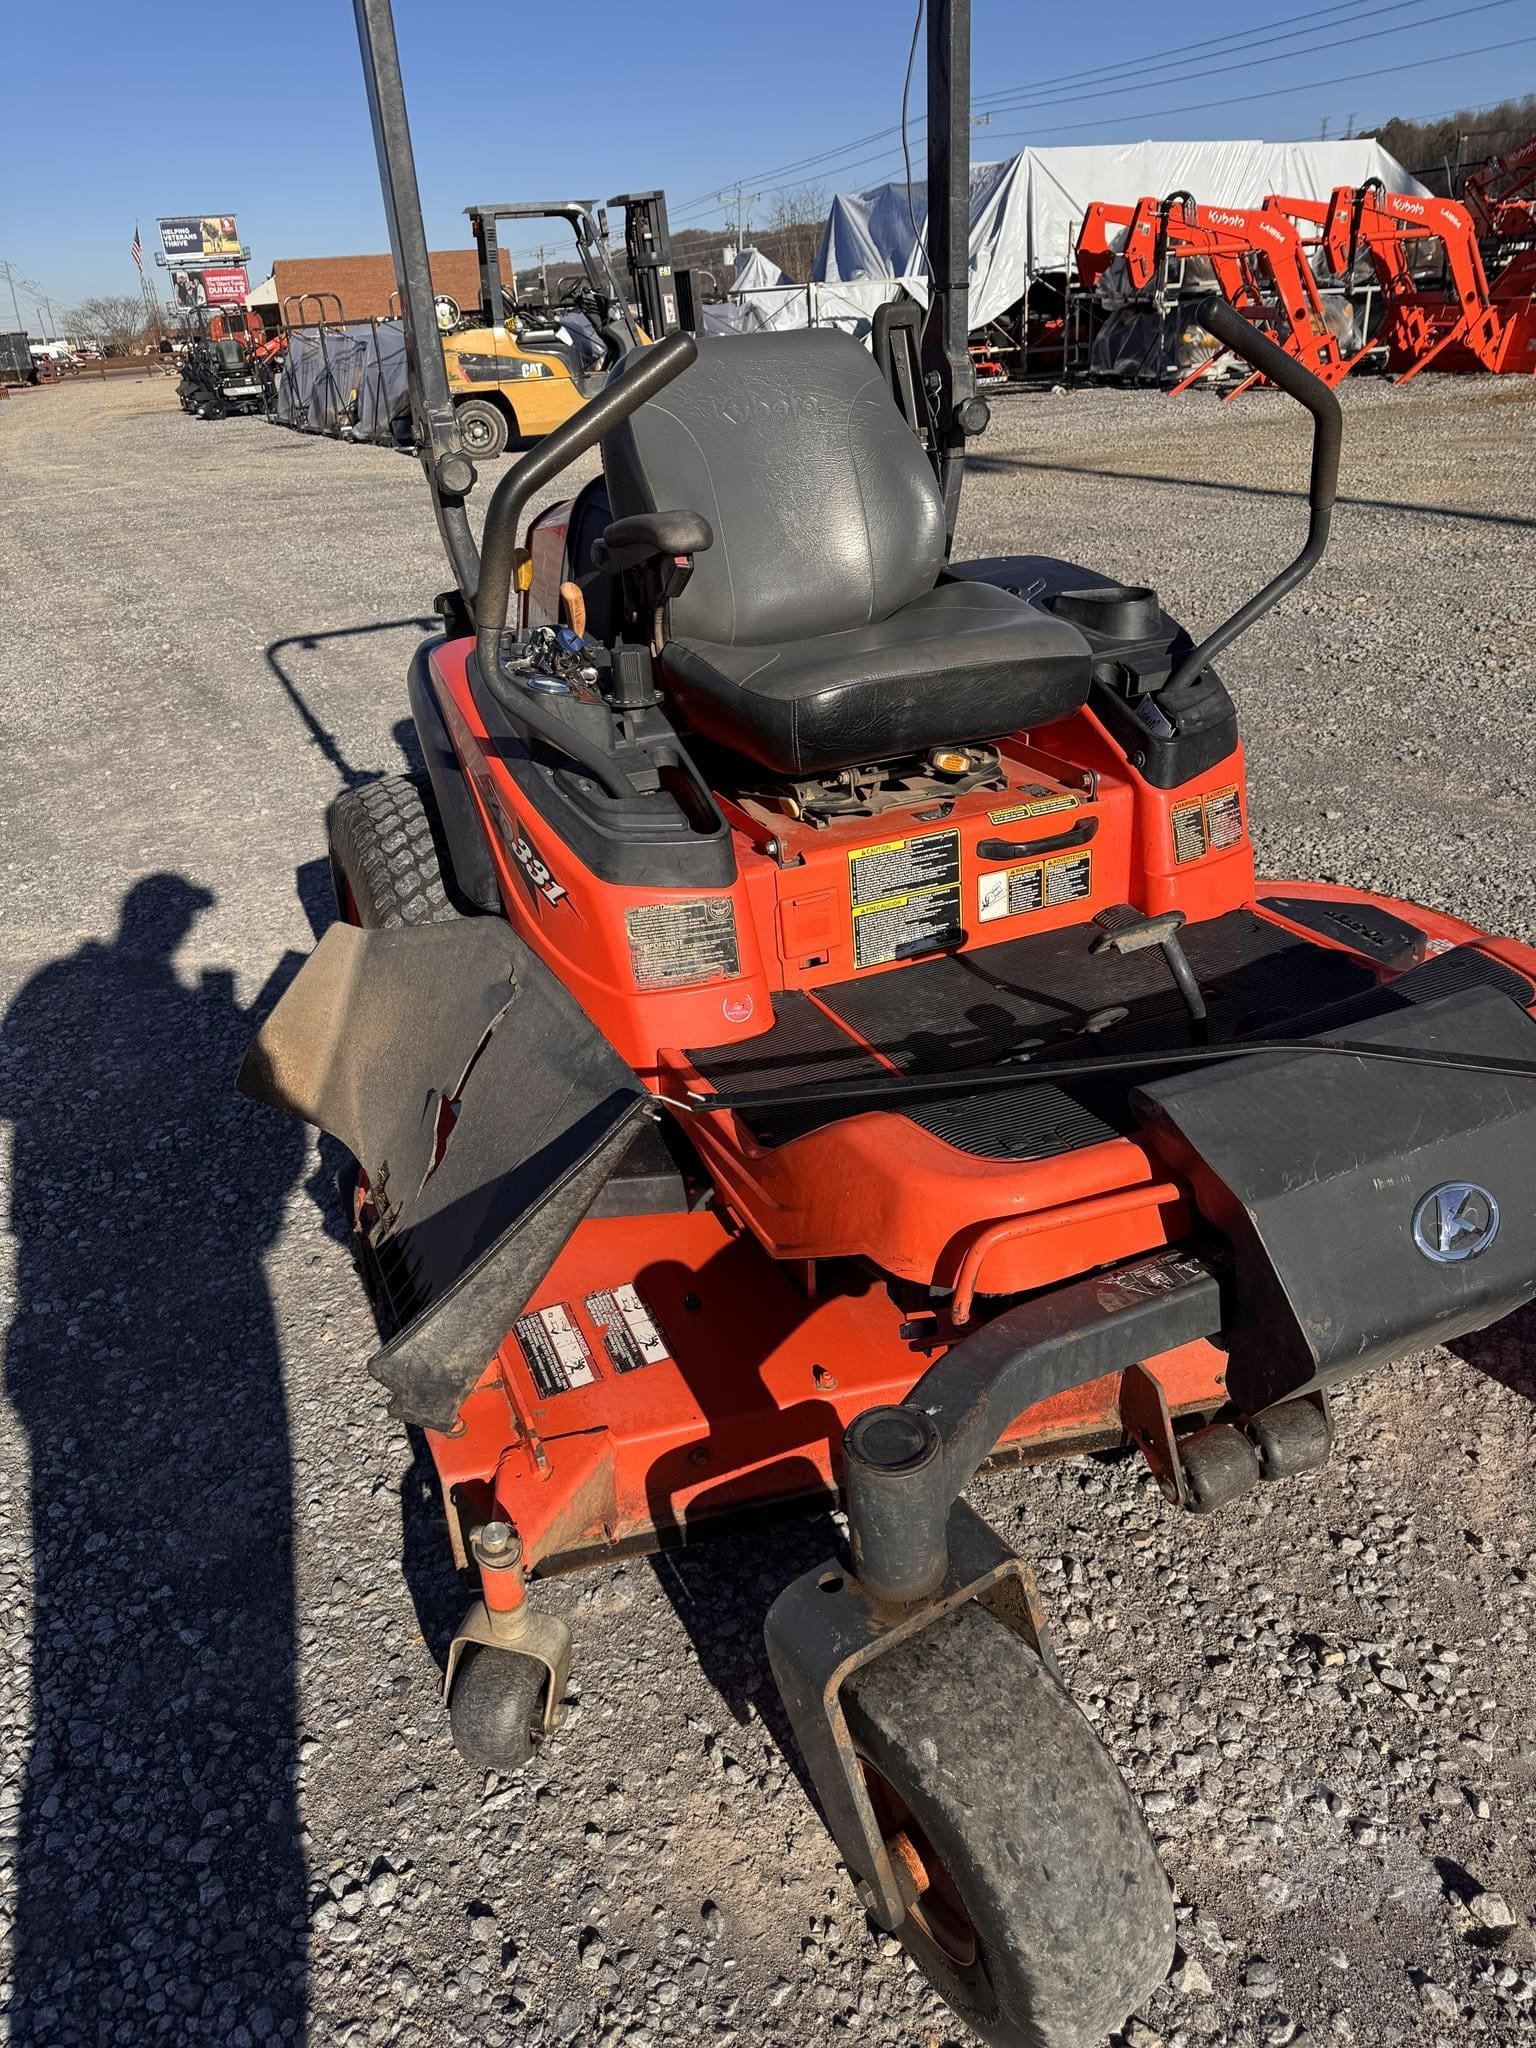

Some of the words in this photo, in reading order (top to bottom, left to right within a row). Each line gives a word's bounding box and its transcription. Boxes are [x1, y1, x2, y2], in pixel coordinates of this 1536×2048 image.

[1392, 198, 1425, 216] Kubota
[1208, 209, 1245, 229] Kubota
[163, 233, 198, 241] VETERANS
[165, 240, 189, 248] THRIVE
[208, 287, 223, 295] DUI
[223, 285, 246, 294] KILLS
[521, 362, 543, 378] CAT
[866, 844, 891, 856] CAUTION
[1053, 851, 1089, 865] ADVERTENCIA
[511, 837, 569, 908] 331
[1015, 863, 1041, 874] WARNING
[574, 1331, 591, 1357] DANGER
